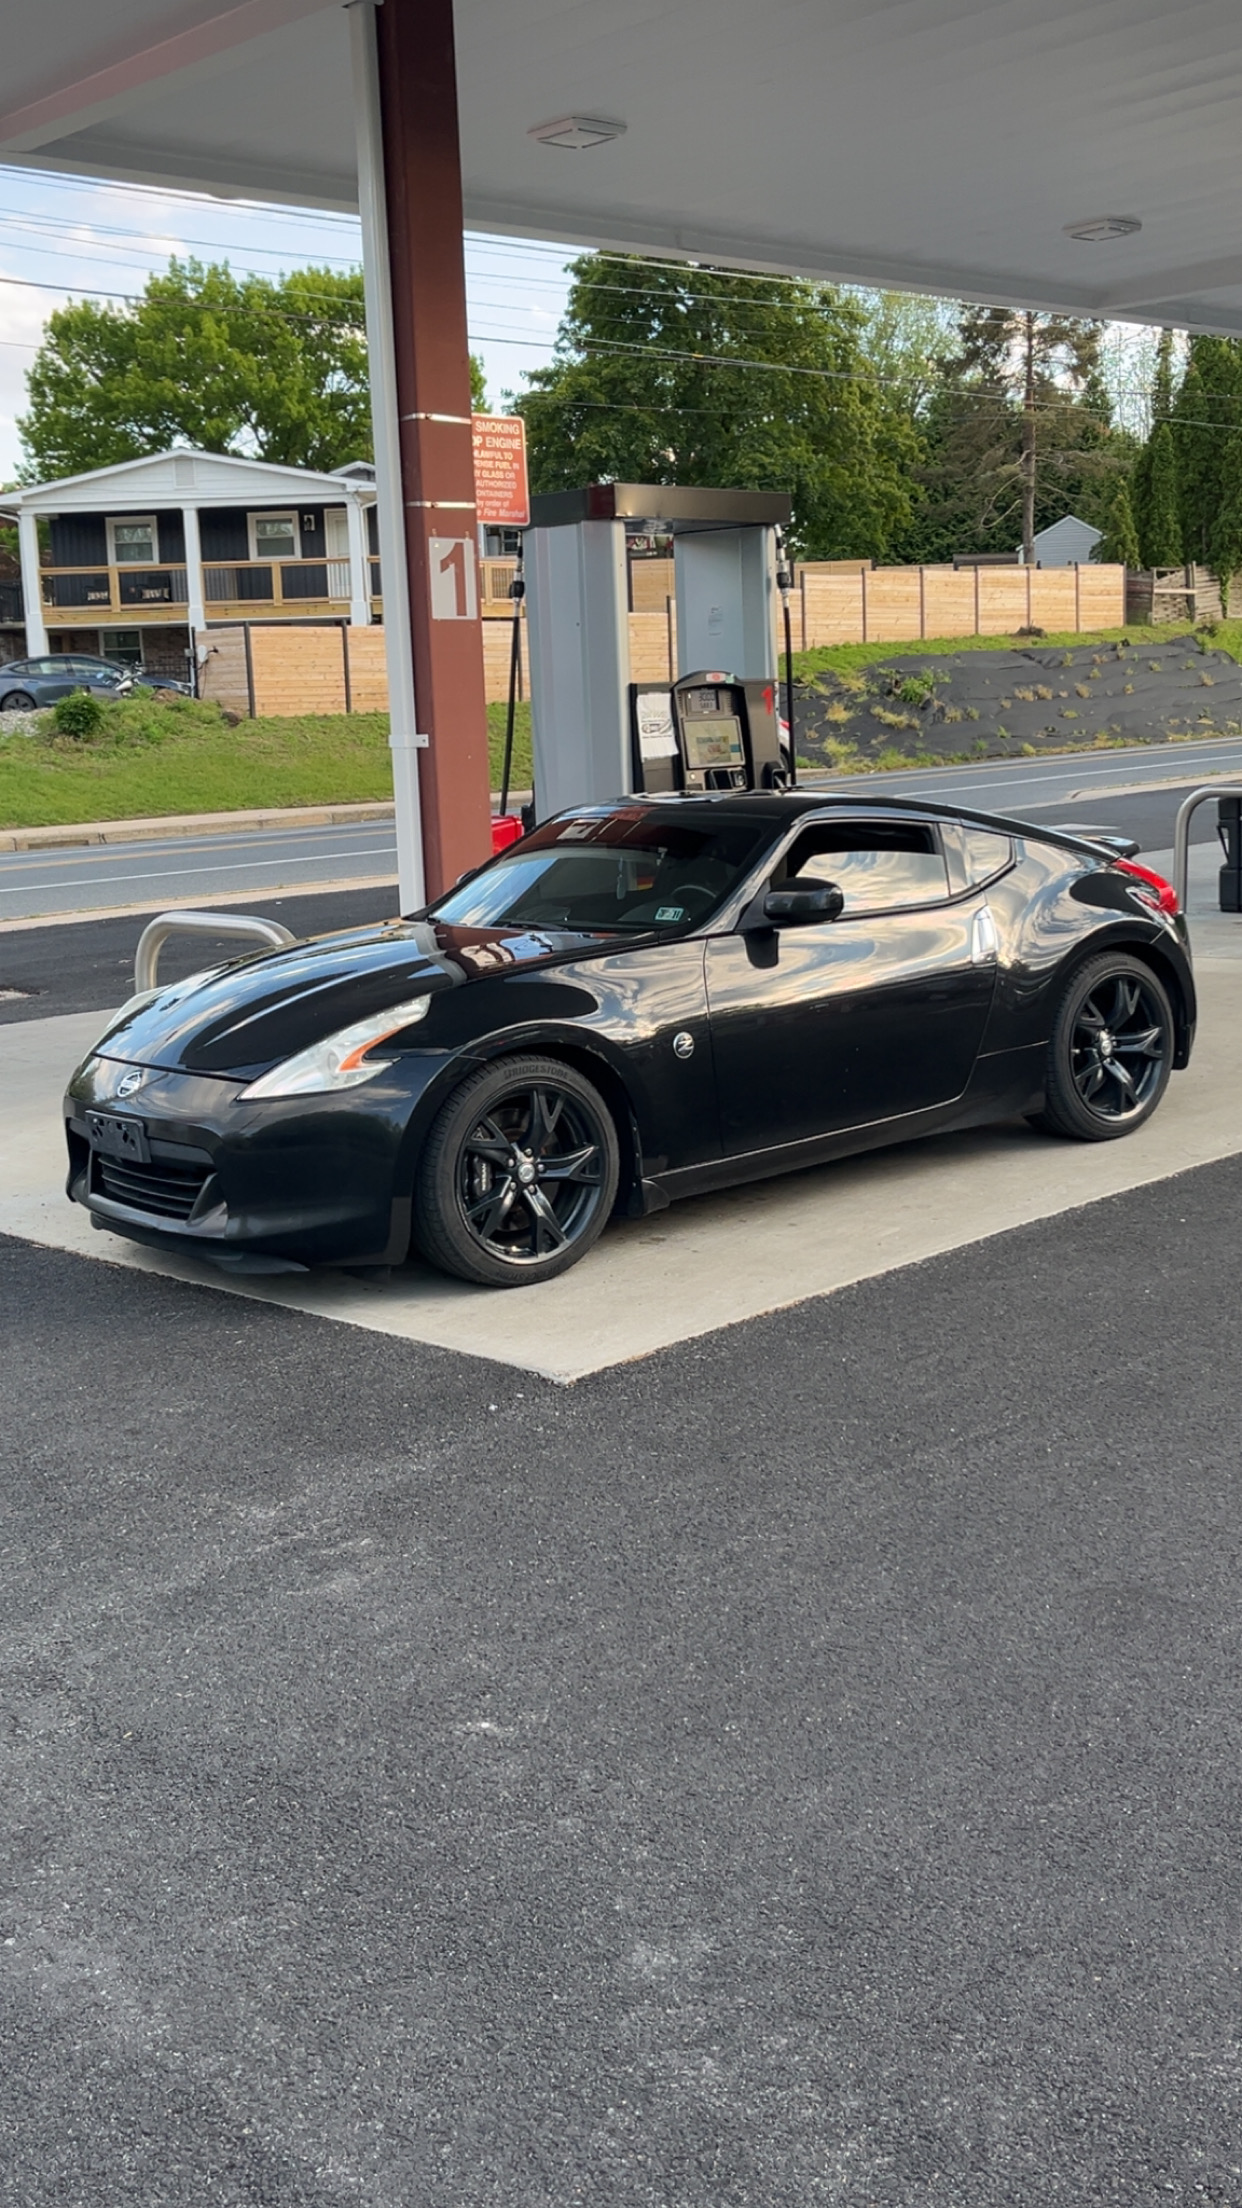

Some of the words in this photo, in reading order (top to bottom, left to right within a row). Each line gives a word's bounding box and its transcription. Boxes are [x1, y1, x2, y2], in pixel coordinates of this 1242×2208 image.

[475, 421, 520, 435] SMOKING
[485, 436, 522, 450] ENGINE
[503, 451, 514, 461] TO
[495, 461, 512, 470] FUEL
[512, 462, 520, 470] IN
[481, 470, 505, 479] GLASS
[477, 498, 484, 508] by
[484, 499, 502, 507] order
[502, 500, 510, 508] of
[483, 507, 497, 517] Fire
[498, 508, 526, 518] Marshal
[440, 542, 467, 616] 1
[762, 686, 773, 715] 1
[503, 1064, 569, 1080] BRIDGESTONE
